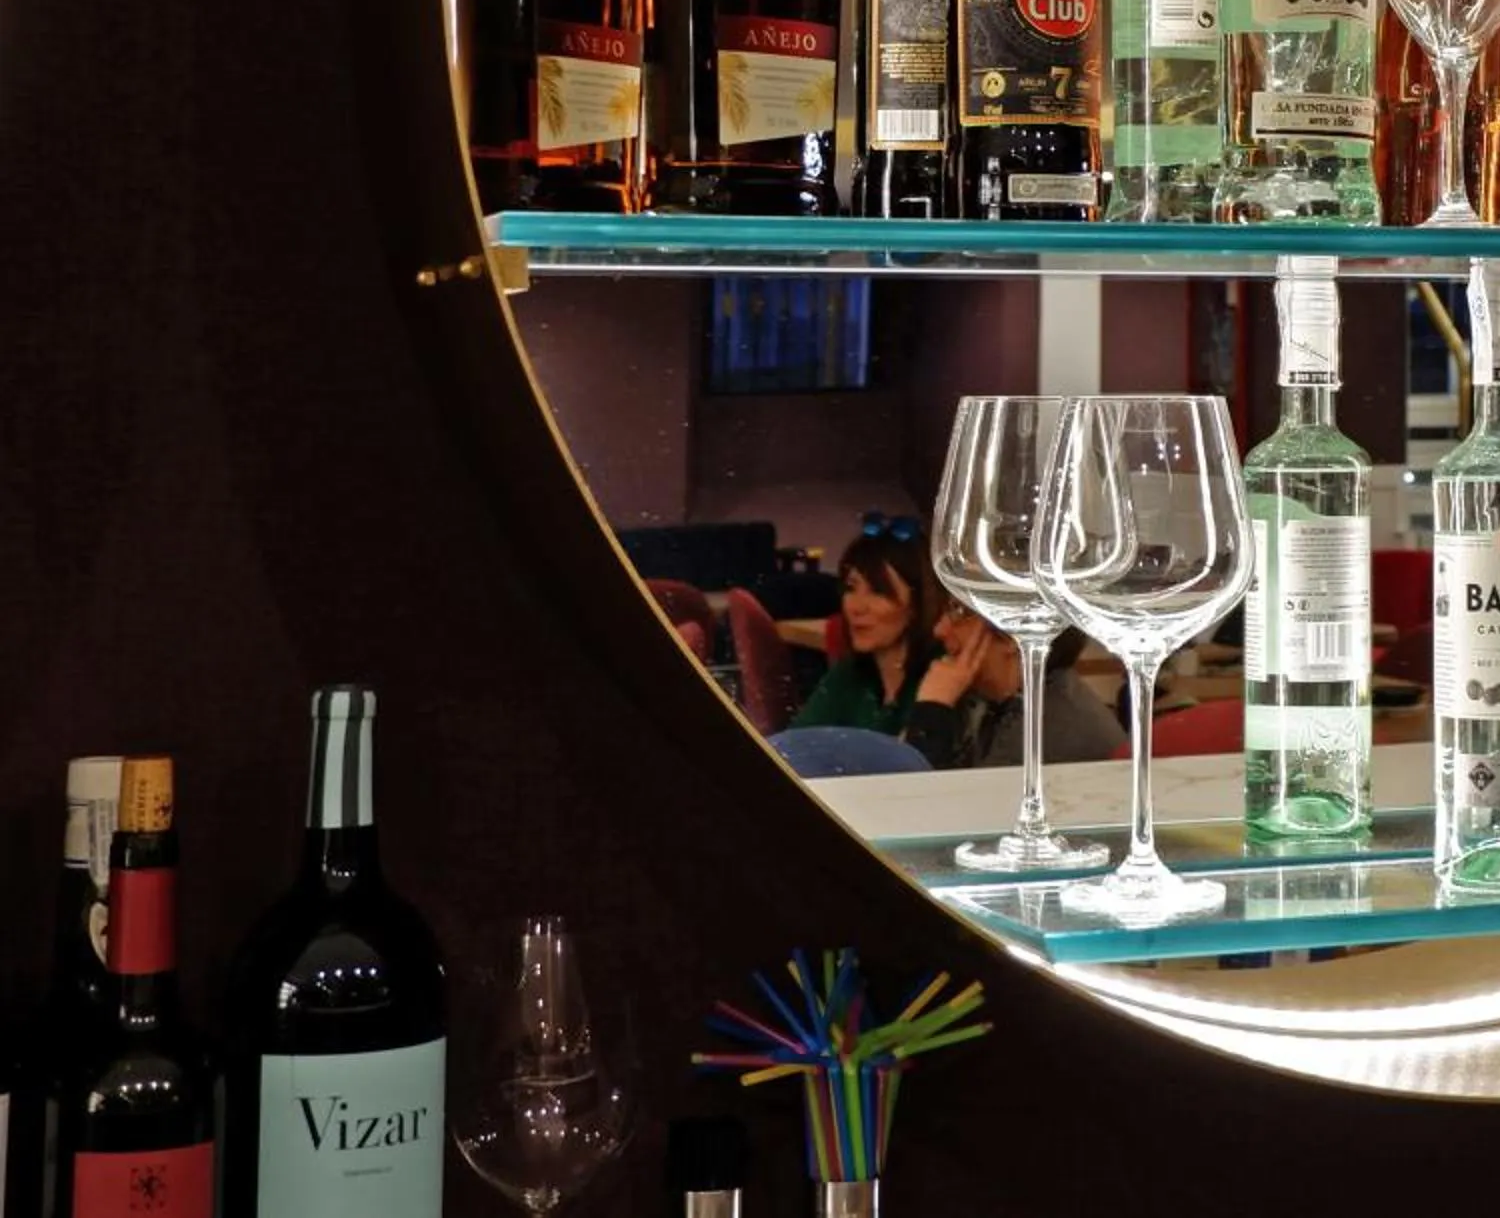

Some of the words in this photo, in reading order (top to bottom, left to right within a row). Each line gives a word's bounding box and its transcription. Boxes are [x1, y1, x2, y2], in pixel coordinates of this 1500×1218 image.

[743, 25, 817, 52] AÑEJO
[1050, 64, 1073, 101] 7
[294, 1095, 428, 1152] Vizar
